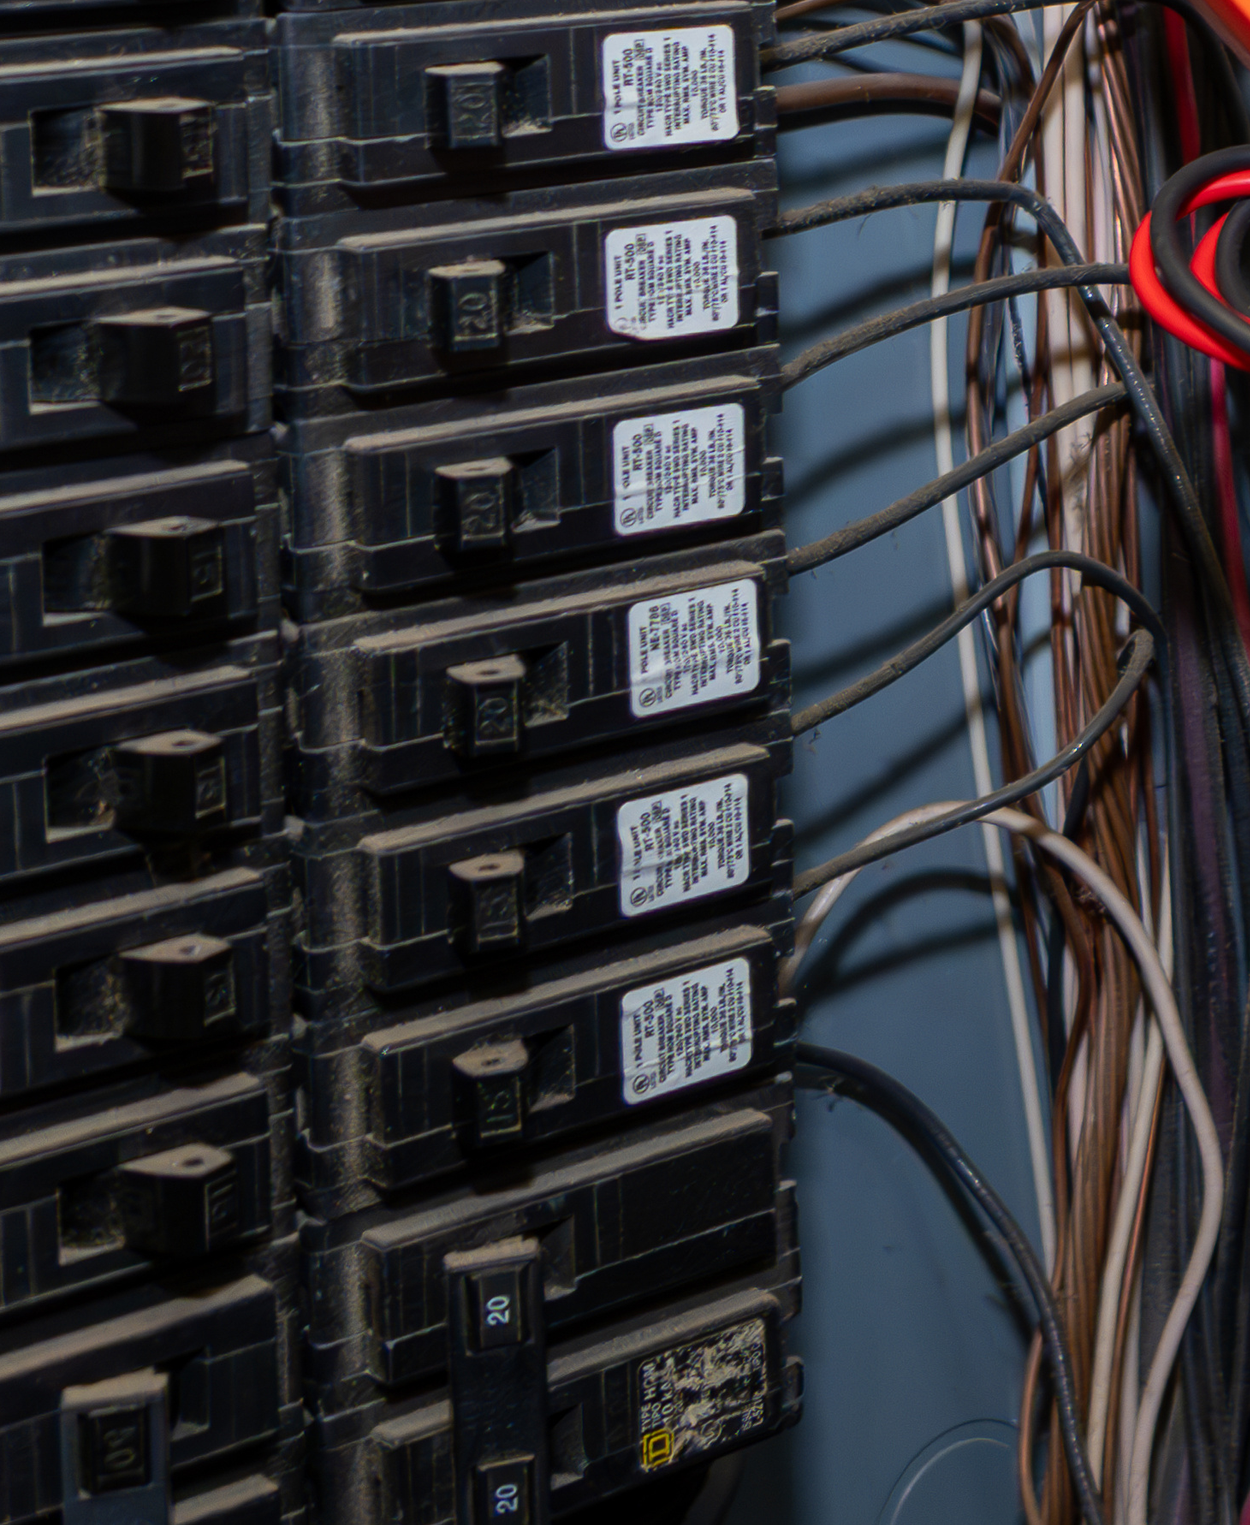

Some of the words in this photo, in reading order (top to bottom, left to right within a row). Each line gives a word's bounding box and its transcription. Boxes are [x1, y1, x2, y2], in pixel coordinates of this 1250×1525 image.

[614, 255, 622, 276] UNIT
[624, 244, 635, 280] RT-500
[455, 292, 489, 331] 20
[632, 434, 643, 471] RT-500
[464, 492, 496, 531] 20
[478, 698, 509, 737] 20
[486, 1295, 511, 1326] 20
[643, 1362, 656, 1400] HOM
[641, 1405, 651, 1432] TYPE
[496, 1484, 519, 1513] 20
